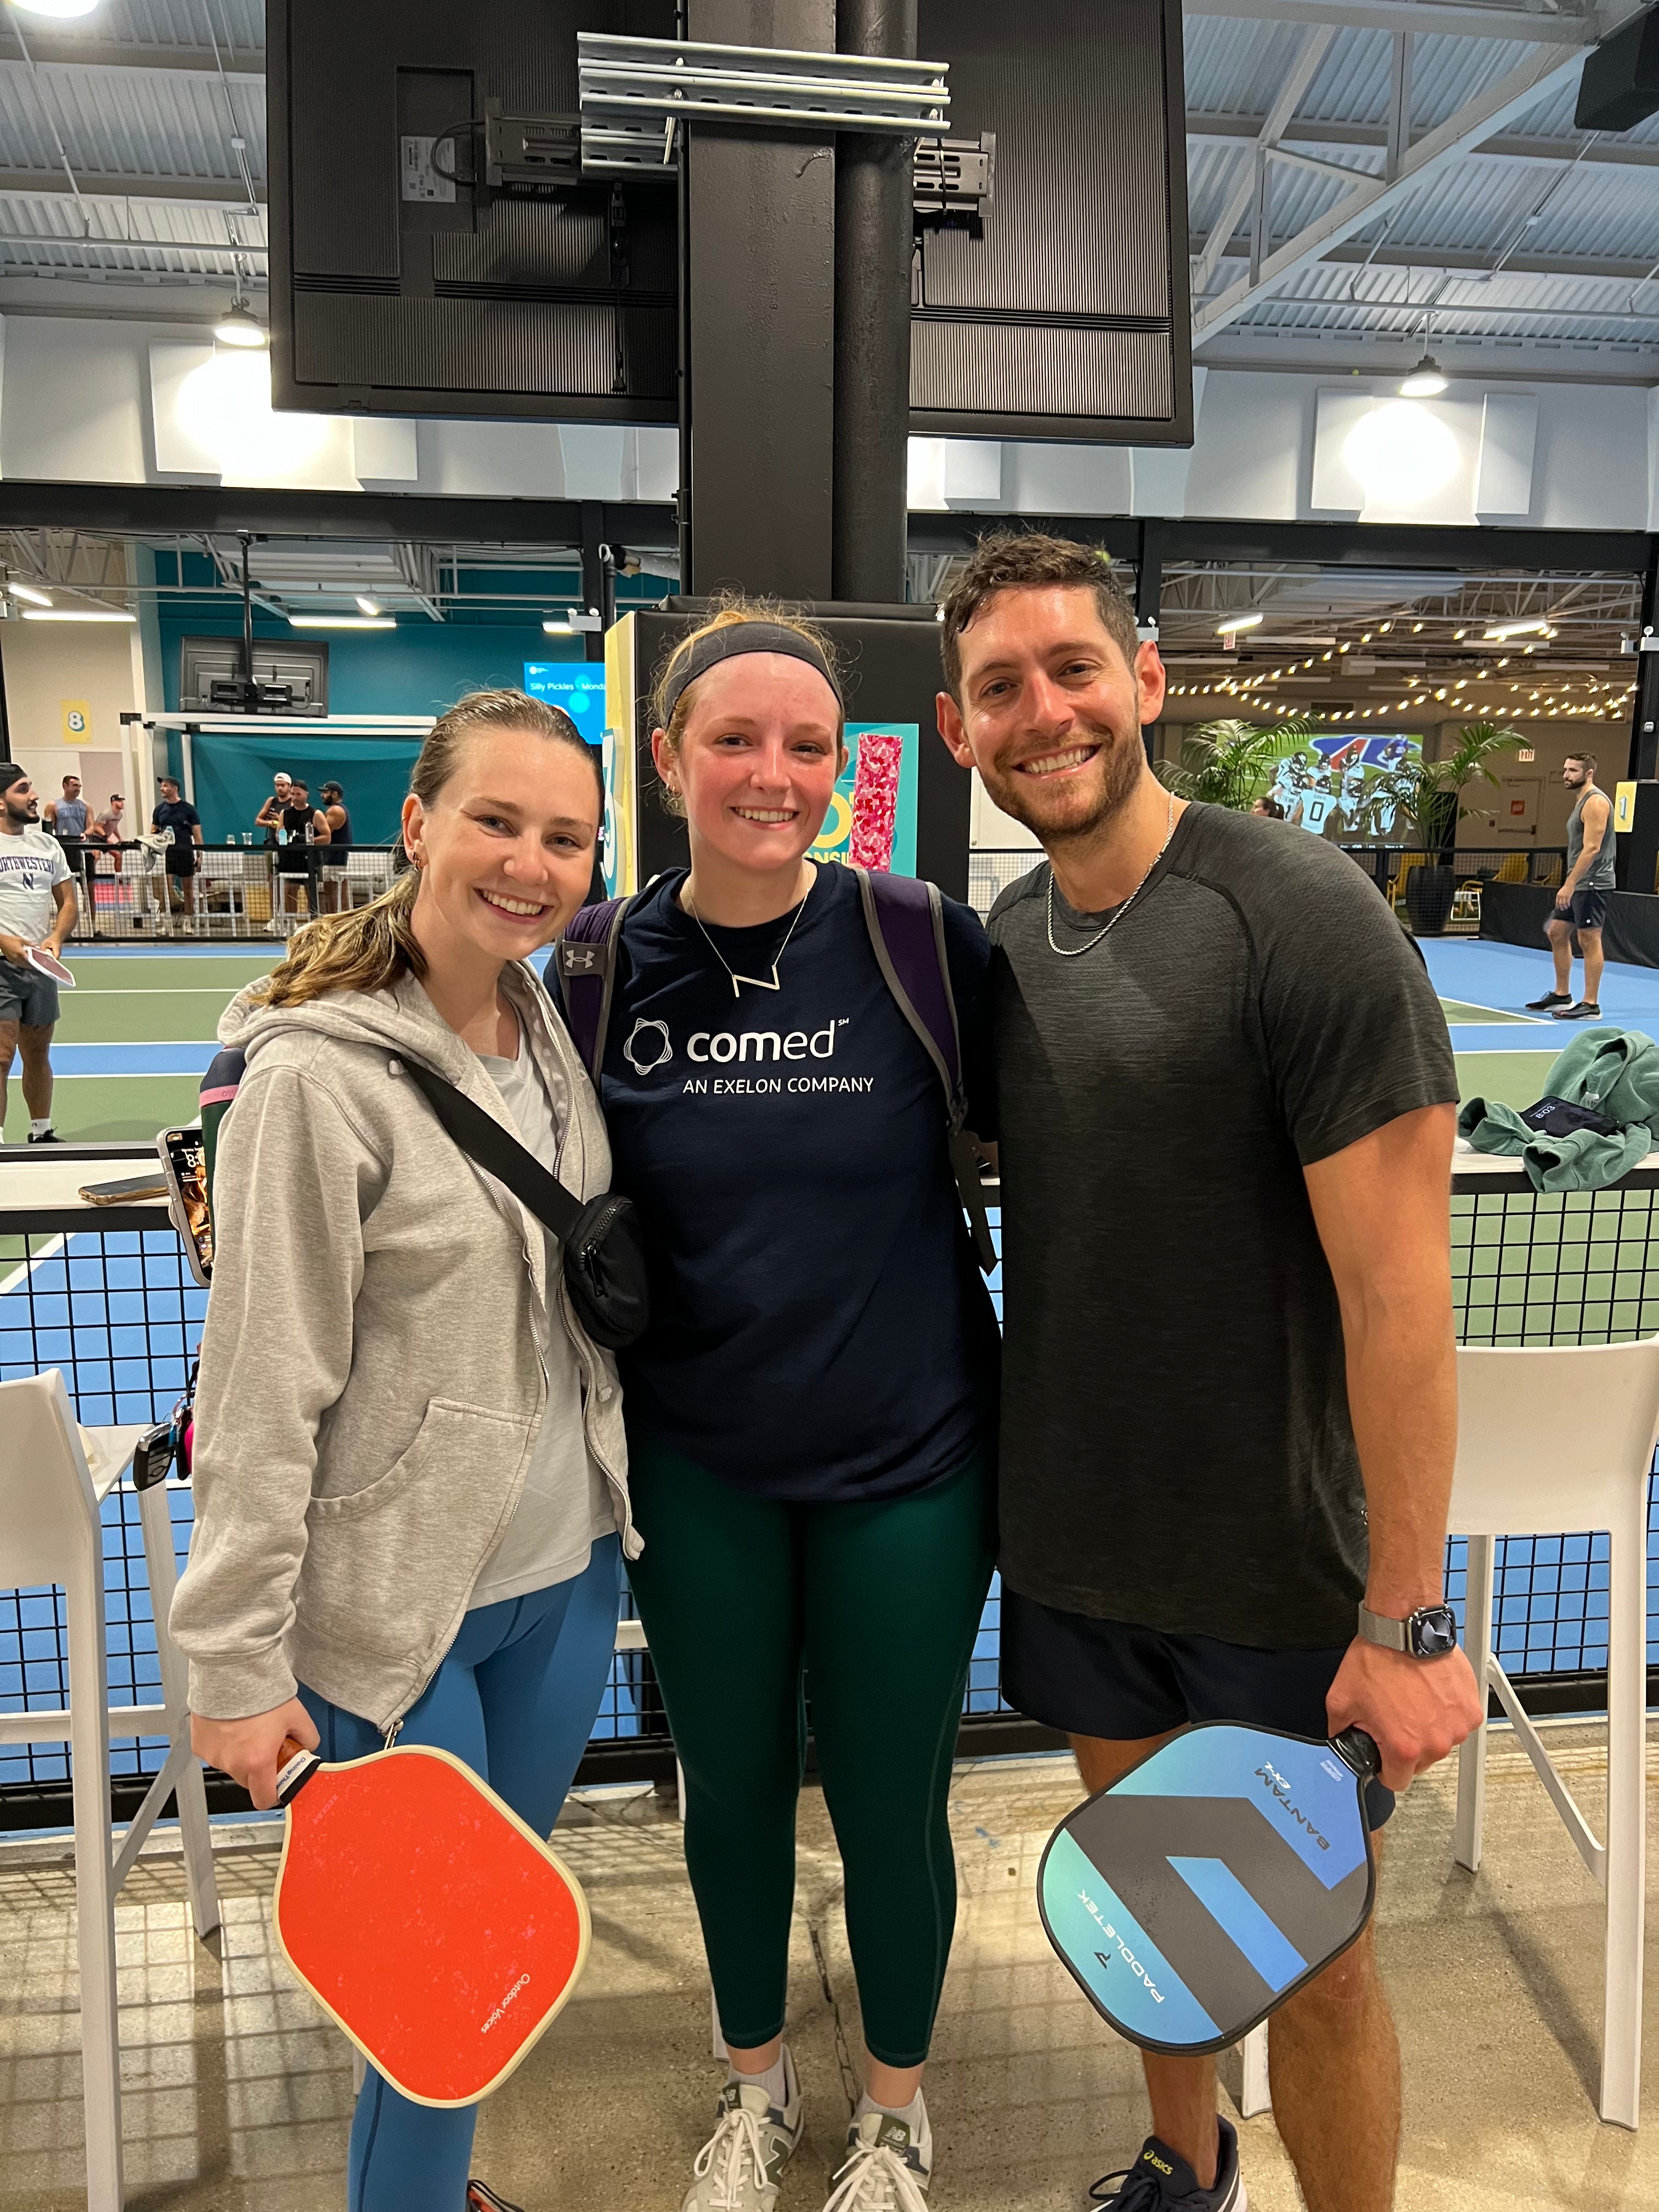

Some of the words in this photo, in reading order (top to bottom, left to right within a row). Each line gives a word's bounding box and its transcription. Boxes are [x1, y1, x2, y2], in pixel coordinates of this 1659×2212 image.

[530, 682, 546, 691] Silly
[547, 682, 574, 691] Pickles
[581, 682, 606, 691] Monda
[68, 710, 85, 732] 8
[1309, 801, 1324, 822] 0
[1620, 795, 1627, 820] 1
[23, 873, 34, 890] N
[687, 1019, 836, 1063] comed
[682, 1079, 708, 1094] AN
[713, 1078, 782, 1094] EXELON
[787, 1077, 874, 1093] COMPANY
[1535, 1105, 1555, 1119] 8:03
[1265, 1761, 1291, 1789] EX-L
[1255, 1768, 1330, 1850] BANTAM
[1077, 1889, 1165, 2004] PADDLETEK
[501, 1973, 531, 2008] Outdoor
[481, 2008, 505, 2034] Voices
[1151, 2156, 1173, 2175] asics
